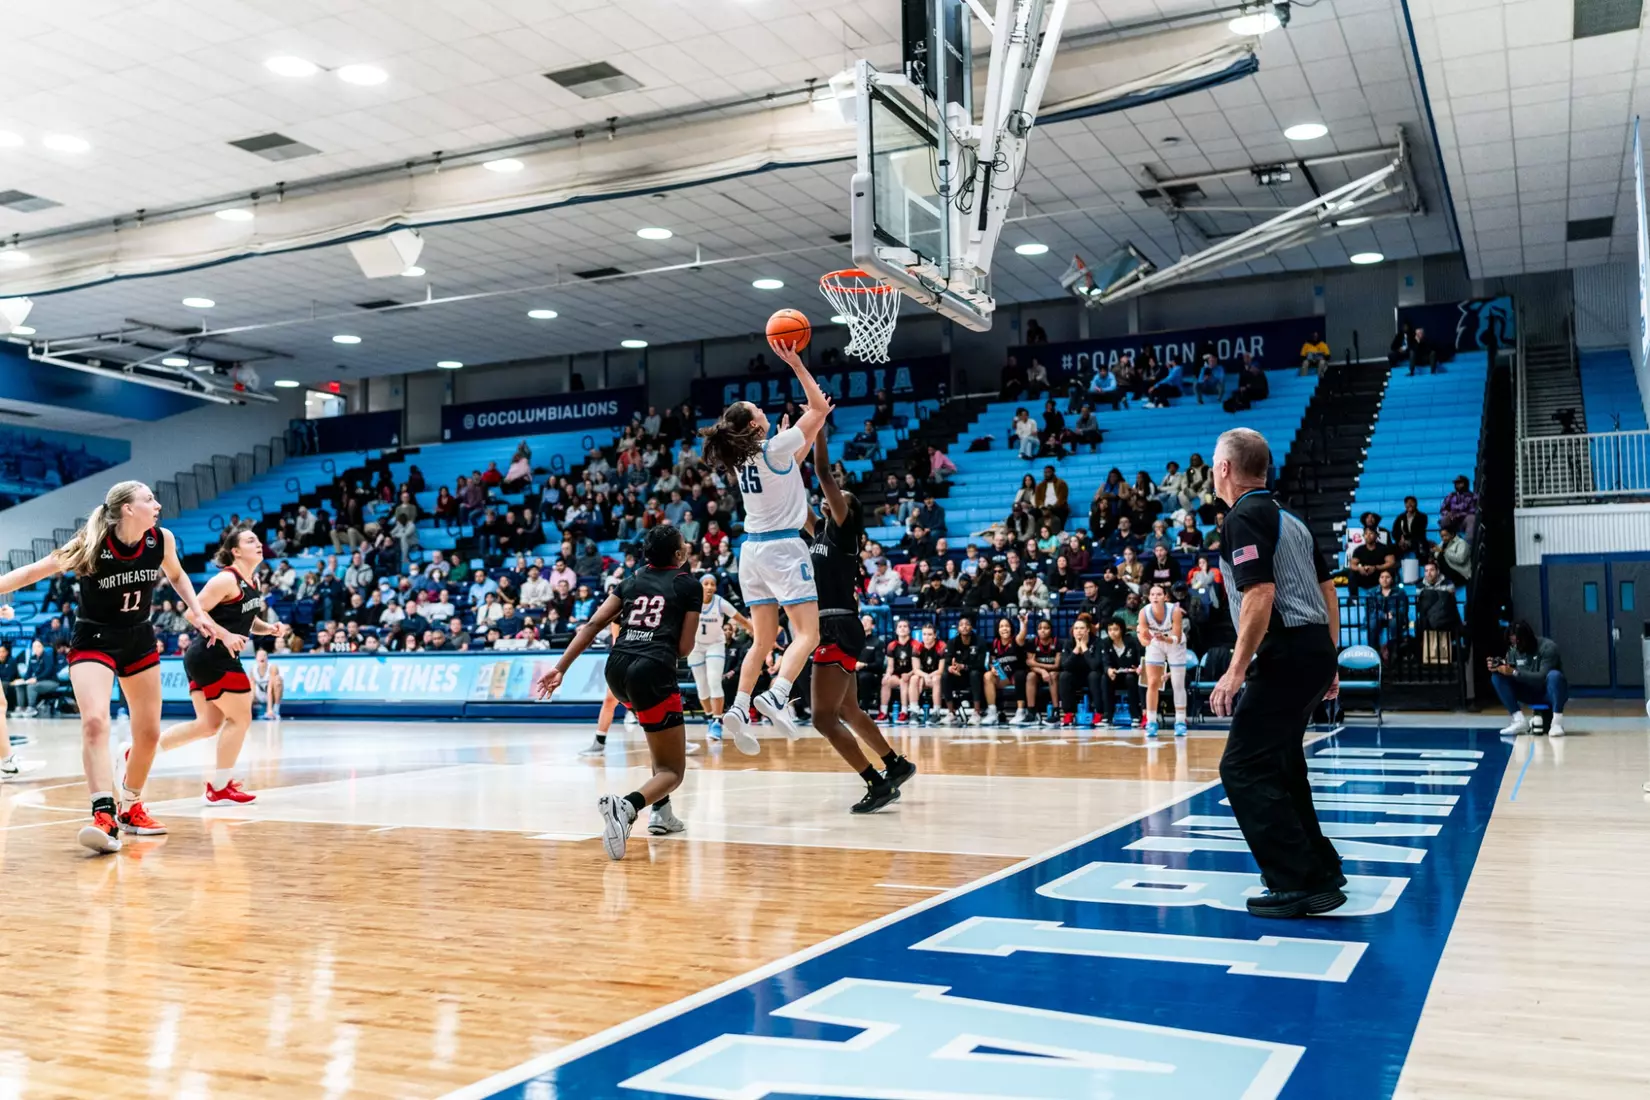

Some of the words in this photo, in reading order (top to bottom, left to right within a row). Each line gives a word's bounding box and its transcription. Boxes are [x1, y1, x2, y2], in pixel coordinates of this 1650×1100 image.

[120, 590, 142, 613] 11
[628, 595, 666, 628] 23
[291, 664, 333, 692] FOR
[338, 662, 384, 692] ALL
[389, 662, 461, 692] TIMES
